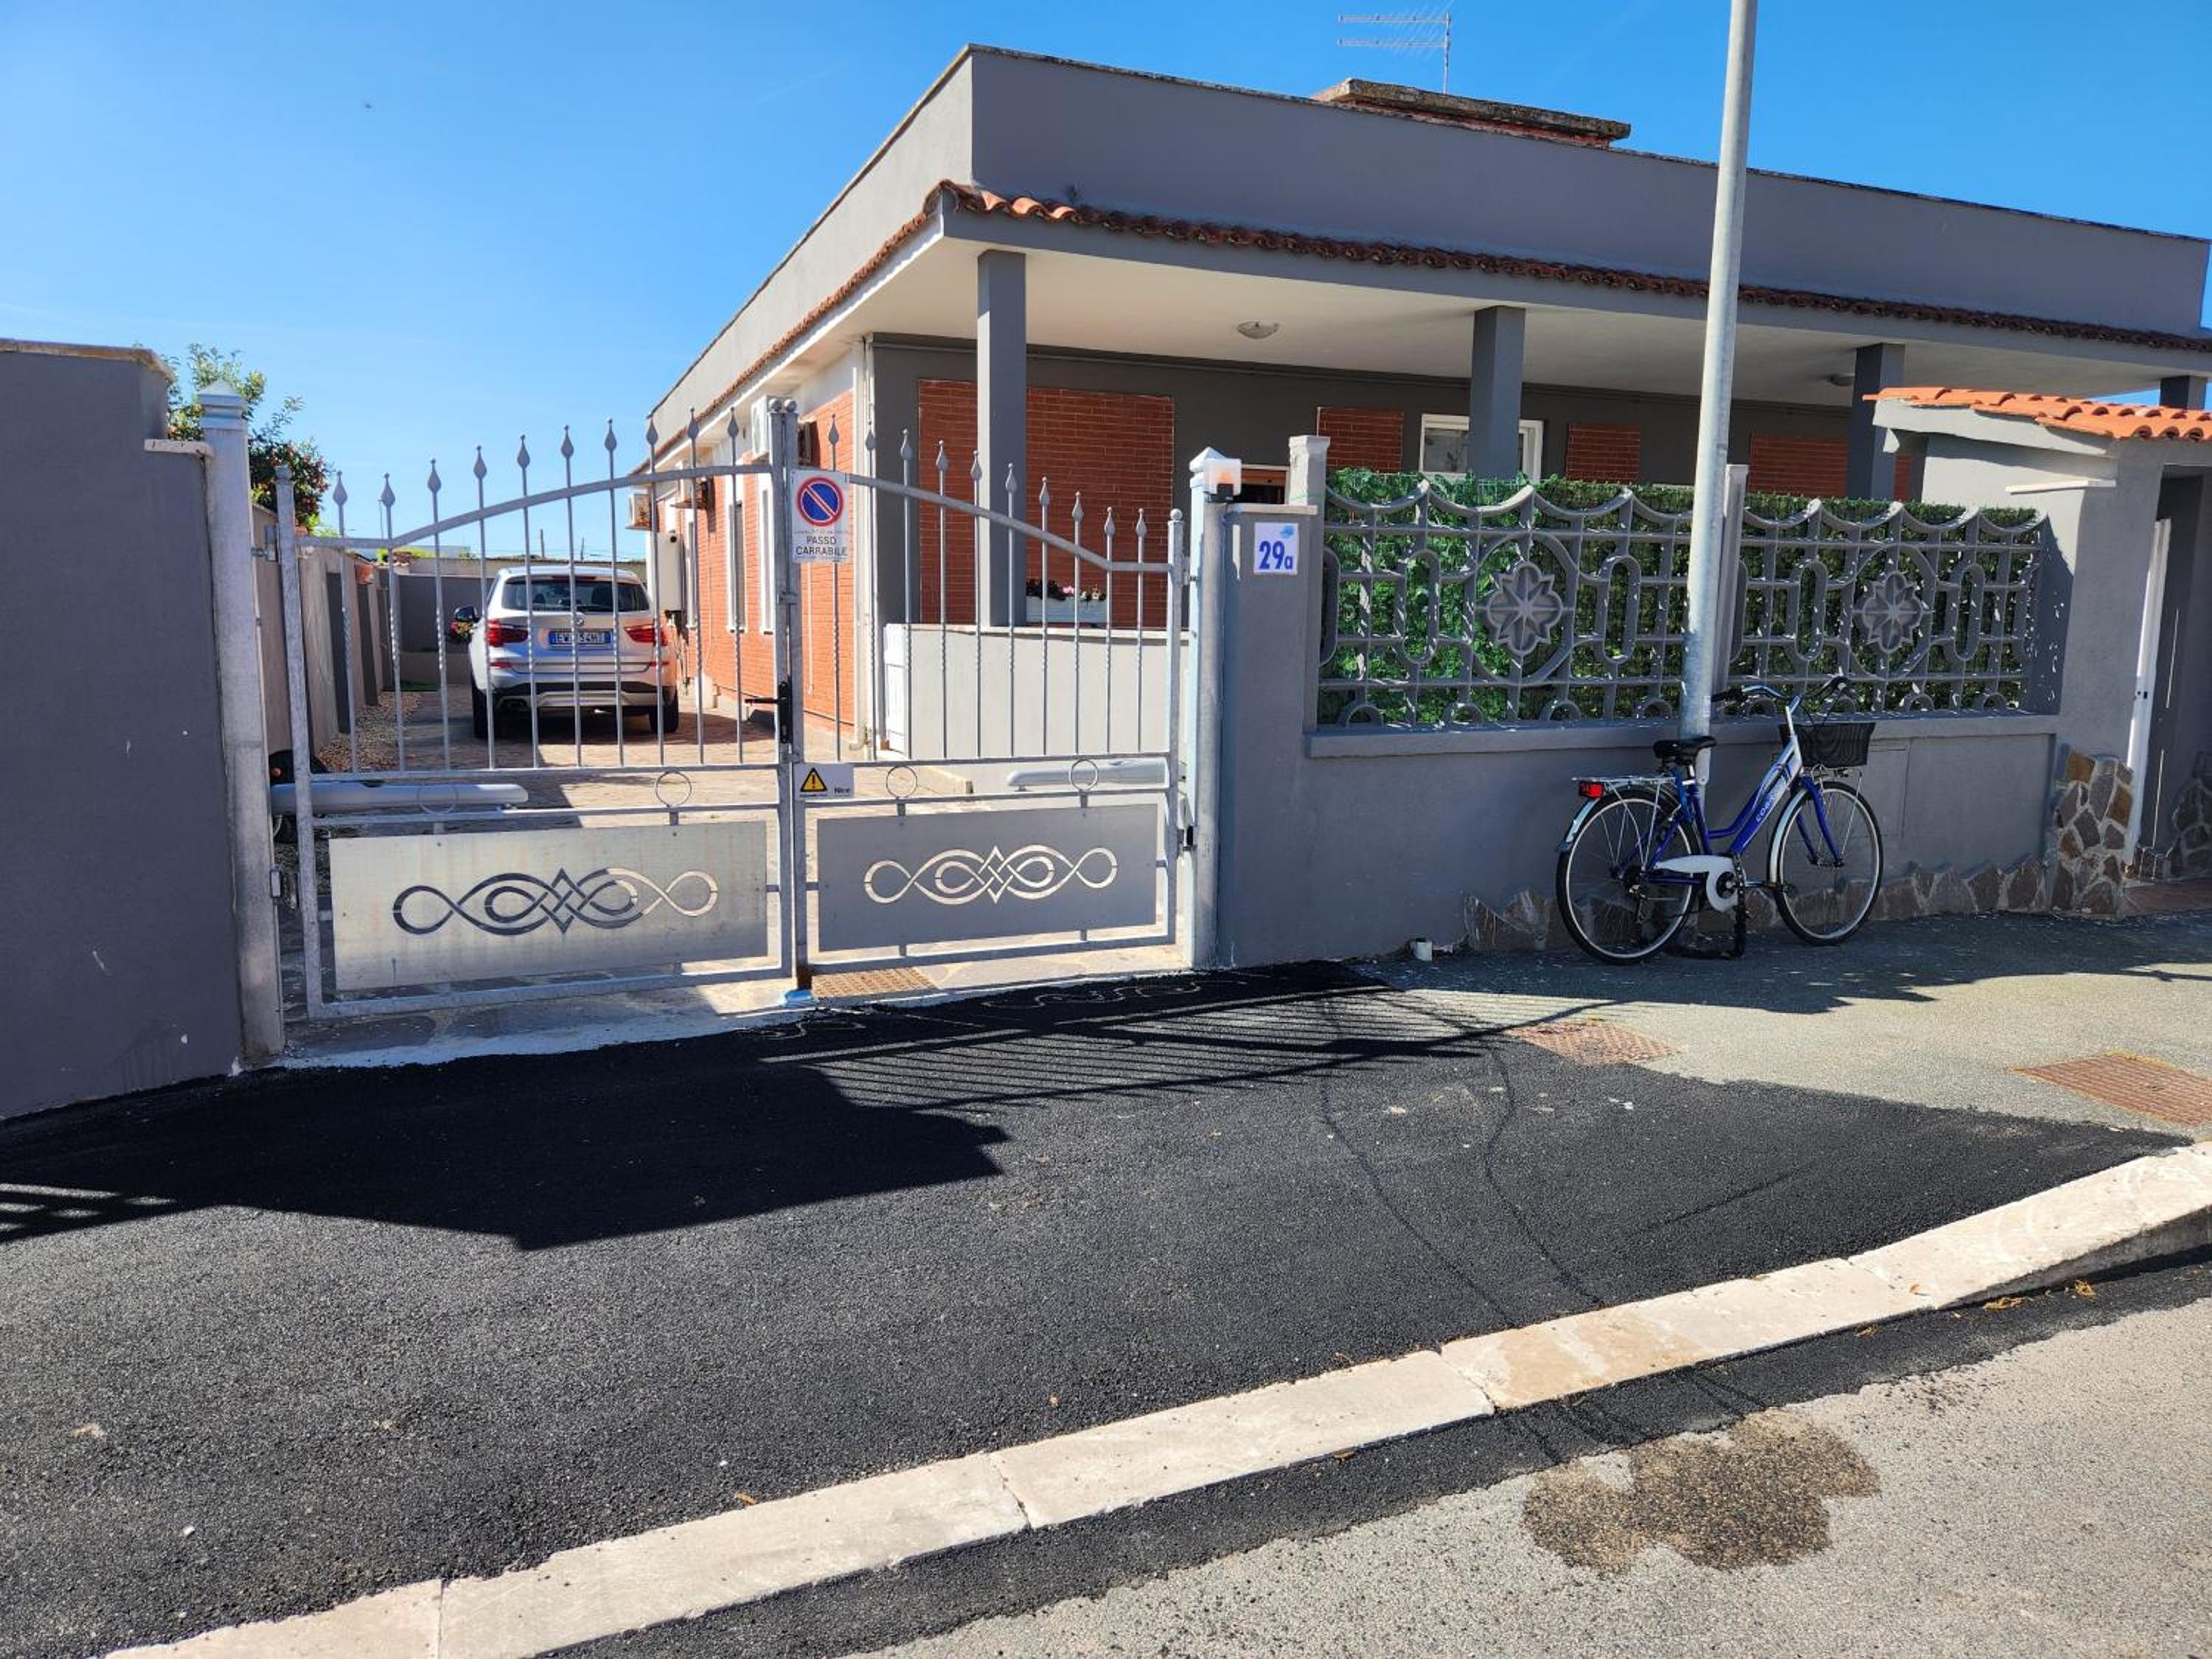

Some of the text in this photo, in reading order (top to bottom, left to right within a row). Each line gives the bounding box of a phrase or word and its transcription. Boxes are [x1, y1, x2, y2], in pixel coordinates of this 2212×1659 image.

[806, 536, 837, 545] PASSO
[796, 546, 848, 556] CARRABILE
[1259, 540, 1293, 570] 29a
